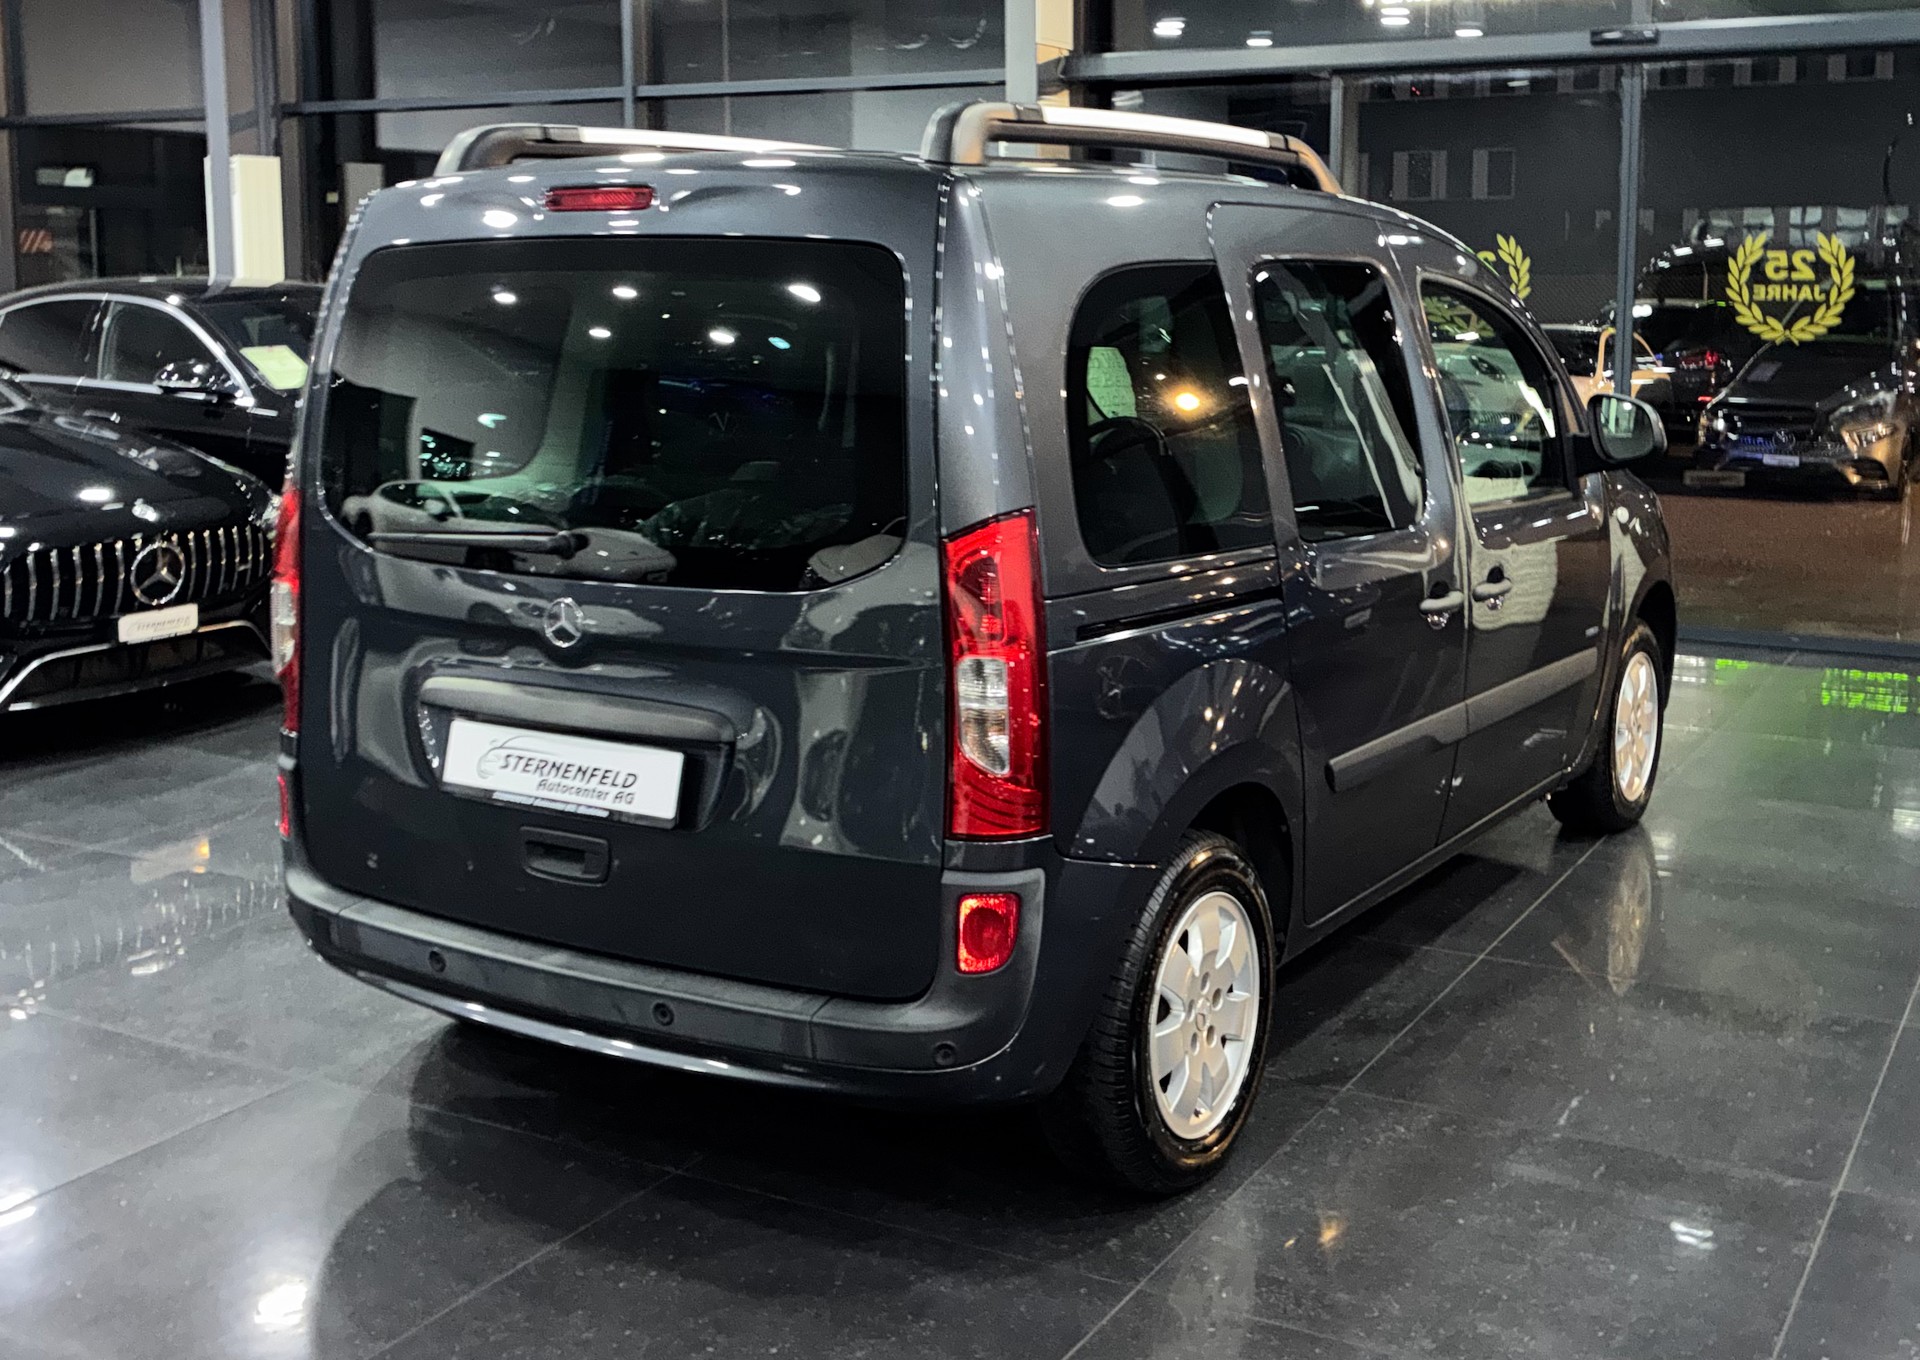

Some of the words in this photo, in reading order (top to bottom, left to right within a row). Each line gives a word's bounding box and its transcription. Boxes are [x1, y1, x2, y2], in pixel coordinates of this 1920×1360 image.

[499, 754, 638, 789] STERNENFELD
[536, 778, 610, 801] Autocenter
[612, 791, 636, 805] AG
